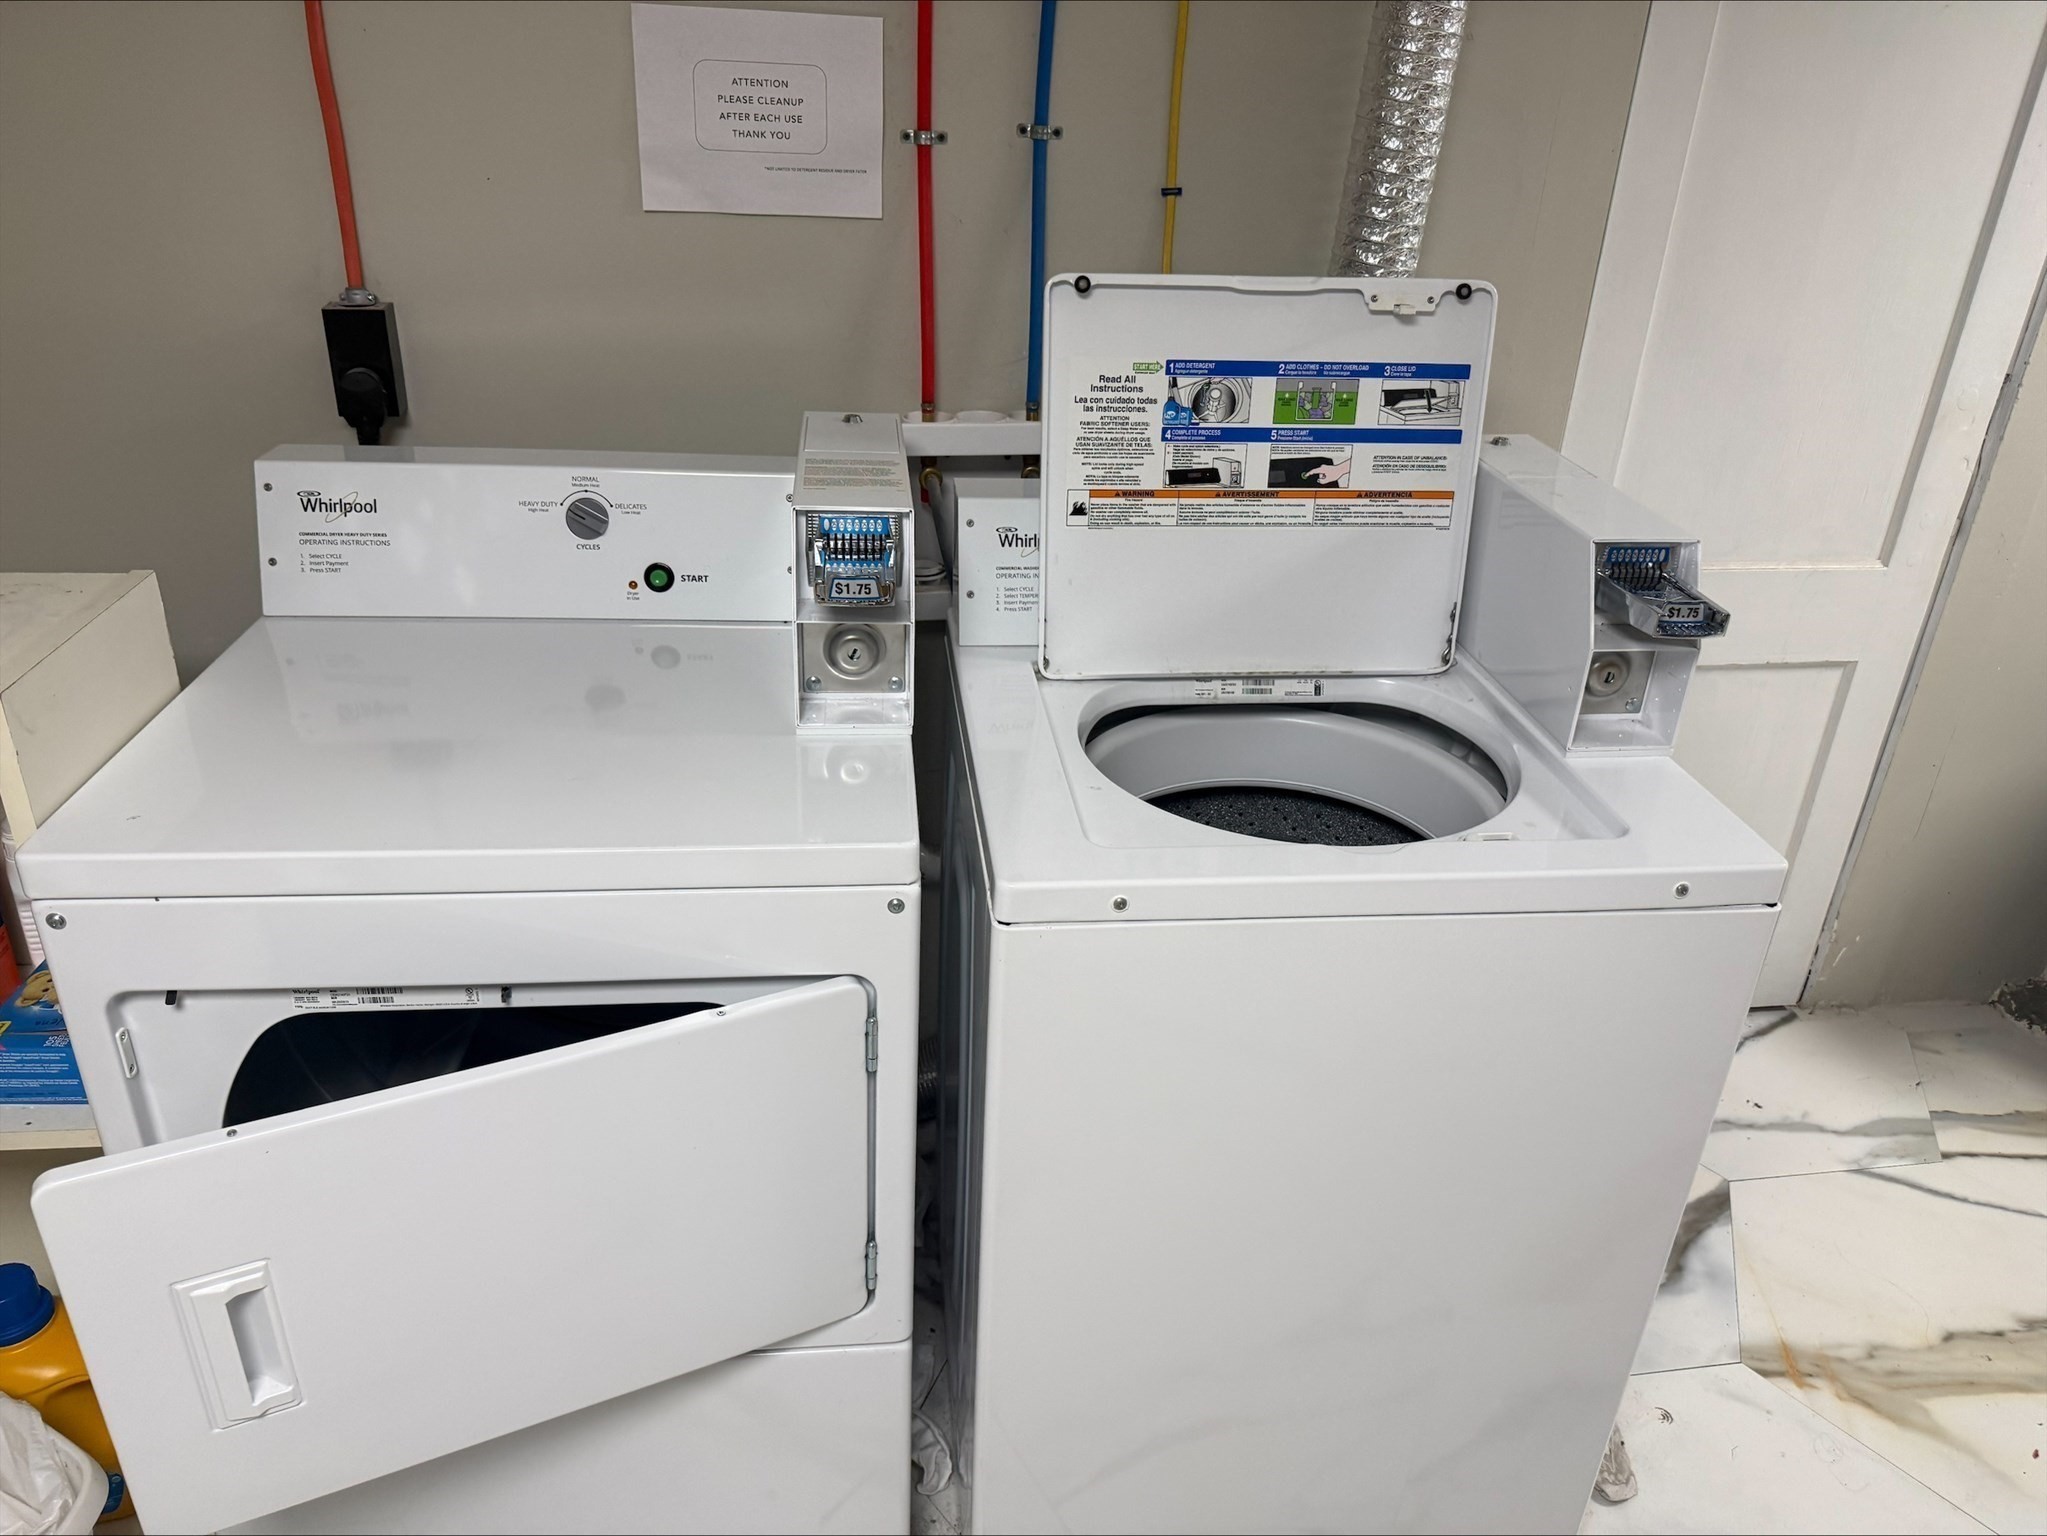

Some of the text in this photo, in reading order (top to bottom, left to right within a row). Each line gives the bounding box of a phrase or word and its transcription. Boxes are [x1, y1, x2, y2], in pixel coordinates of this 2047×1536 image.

[732, 77, 788, 88] ATTENTION
[717, 94, 804, 106] PLEASE CLEANUP
[719, 112, 803, 124] AFTER EACH USE
[732, 129, 791, 140] THANK YOU
[1169, 362, 1174, 373] 1
[1278, 363, 1285, 374] 2
[1384, 365, 1391, 376] 3
[1099, 375, 1136, 383] Read All
[1090, 384, 1144, 393] Instructions
[1074, 395, 1088, 404] Lea
[1105, 396, 1135, 404] cuidado
[1137, 397, 1158, 405] todas
[1083, 404, 1148, 413] las instrucciones.
[1164, 429, 1172, 440] 4
[1270, 429, 1277, 440] 5
[300, 497, 378, 517] Whirlpool
[340, 539, 391, 547] INSTRUCTIONS
[680, 574, 709, 583] START
[835, 581, 872, 595] $1.75
[1667, 606, 1700, 619] $1.75
